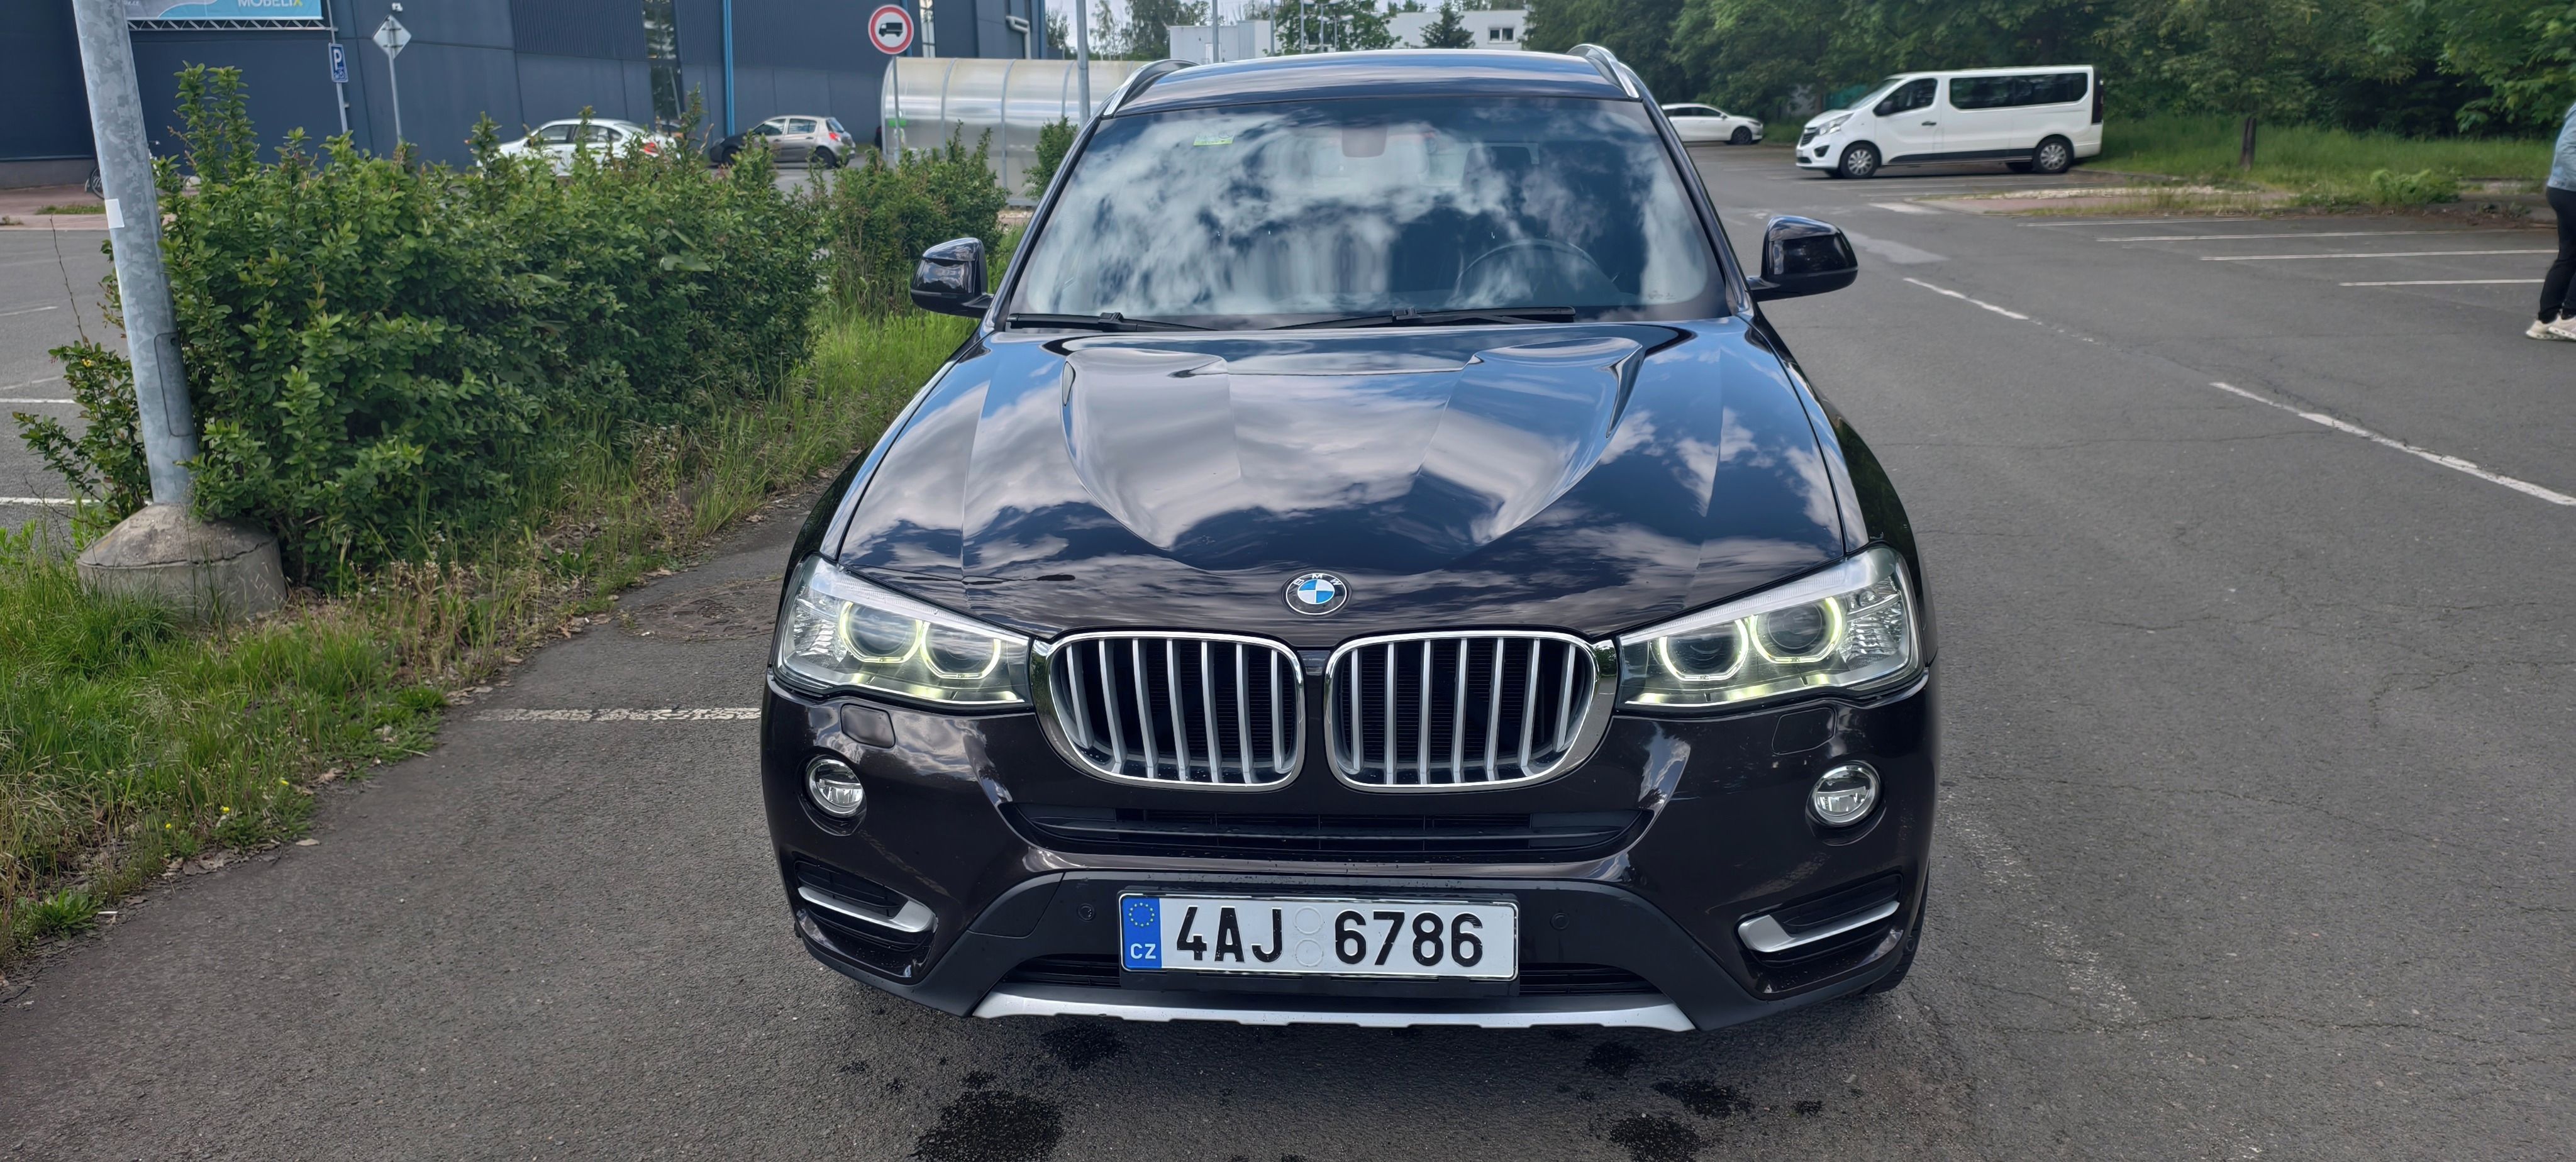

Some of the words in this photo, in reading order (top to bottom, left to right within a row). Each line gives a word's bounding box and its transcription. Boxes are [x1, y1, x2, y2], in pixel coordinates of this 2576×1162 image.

[333, 49, 342, 71] P
[1292, 573, 1342, 586] BMW
[1177, 905, 1284, 963] 4AJ
[1335, 910, 1484, 968] 6786
[1130, 943, 1157, 960] CZ
